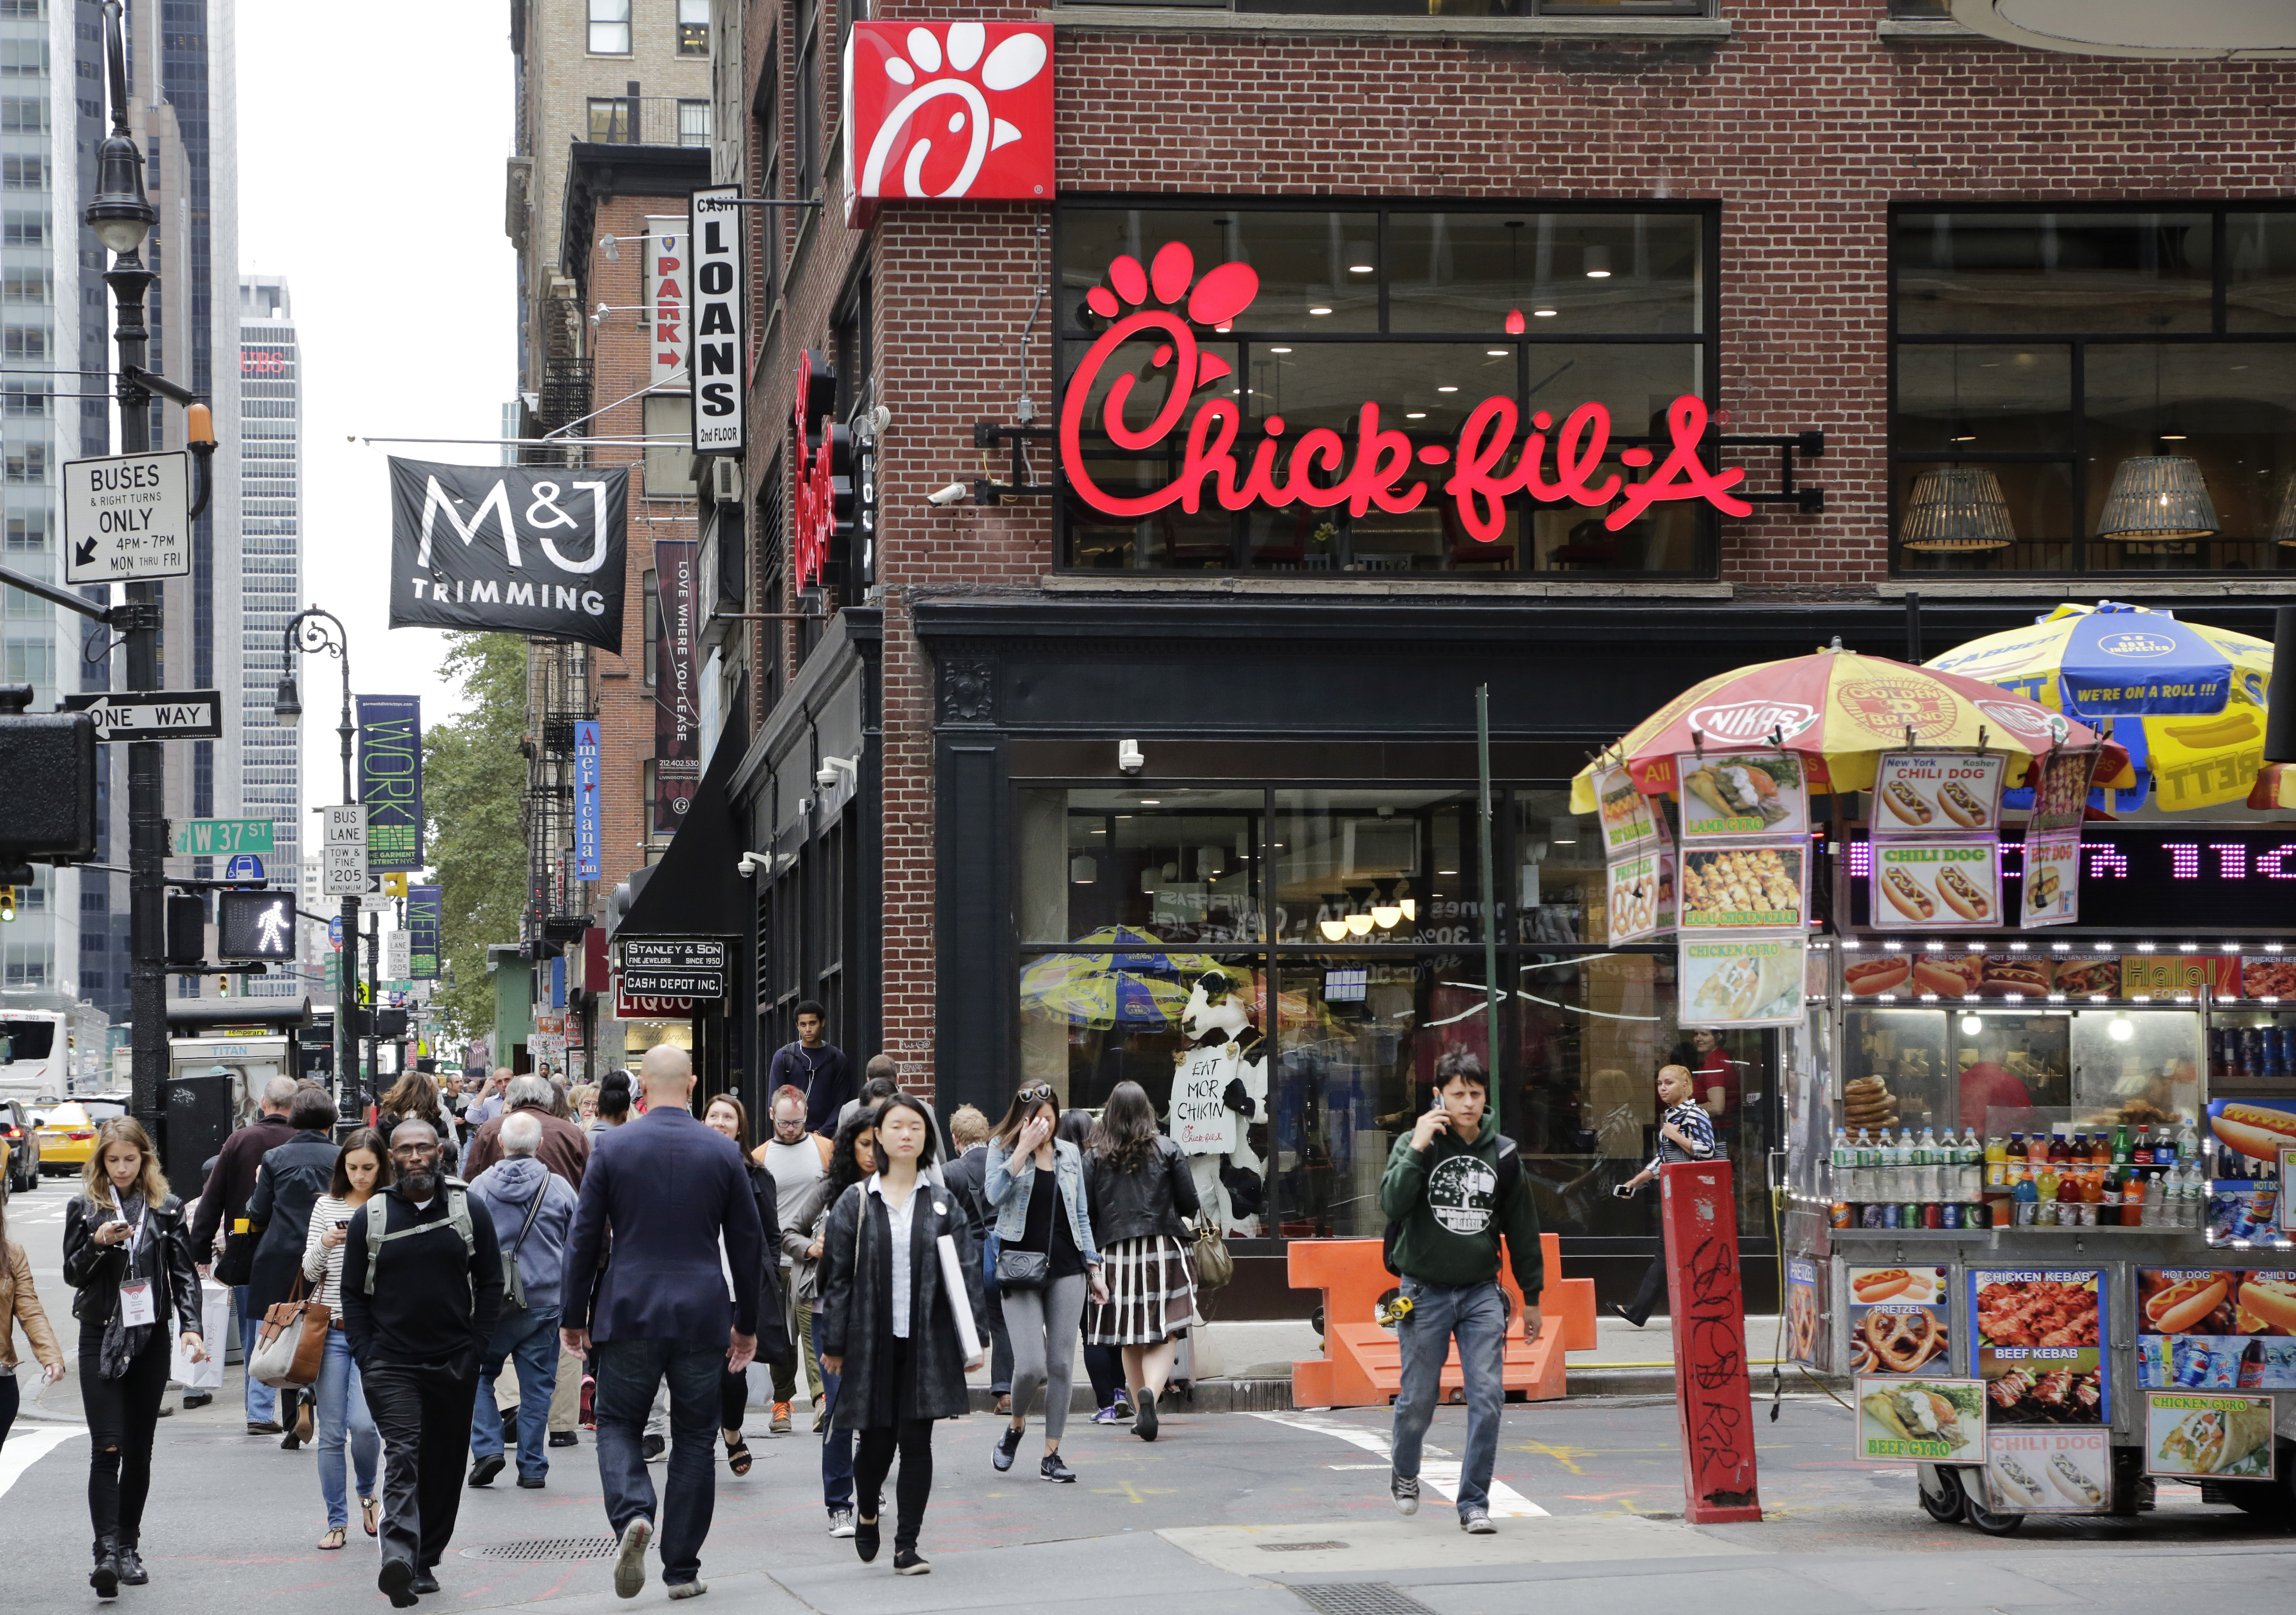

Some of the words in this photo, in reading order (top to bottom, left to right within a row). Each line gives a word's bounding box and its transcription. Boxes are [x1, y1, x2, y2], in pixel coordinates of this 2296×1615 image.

[656, 257, 682, 343] PARK
[699, 221, 735, 416] LOANS
[240, 351, 284, 372] UBS
[1060, 242, 1753, 541] Chick-fil-A
[700, 430, 712, 442] 2nd
[714, 427, 737, 441] FLOOR
[91, 464, 159, 491] BUSES
[91, 498, 97, 506] &
[101, 495, 127, 506] RIGHT
[130, 492, 161, 503] TURNS
[100, 508, 153, 533] ONLY
[417, 475, 607, 574] M&J
[116, 538, 140, 550] 4PM
[151, 535, 174, 548] 7PM
[111, 556, 133, 571] MON
[140, 556, 158, 566] THRU
[164, 552, 180, 566] FRI
[679, 562, 688, 597] LOVE
[412, 578, 604, 615] TRIMMING
[677, 607, 688, 655] WHERE
[1933, 633, 2064, 670] SABRETT
[677, 662, 687, 690] YOU
[1834, 677, 1920, 686] MANUFACTURED
[1849, 687, 1939, 699] GOLDEN
[2077, 688, 2121, 702] WE'RE
[2125, 688, 2144, 700] ON
[2148, 686, 2158, 698] A
[2162, 685, 2197, 698] ROLL
[91, 708, 133, 727] ONE
[155, 707, 200, 725] WAY
[677, 697, 687, 741] LEASE
[1707, 706, 1799, 736] NIKAS
[1871, 712, 1944, 725] BRAND
[1854, 722, 1900, 745] Brooklyn
[364, 718, 415, 820] WORK
[1887, 758, 1909, 767] New
[1914, 758, 1936, 767] York
[1963, 758, 1996, 768] Kosher
[1644, 764, 1671, 783] All
[1897, 768, 1942, 778] CHILI
[1949, 768, 1985, 778] DOG
[578, 727, 597, 857] Americana
[334, 812, 356, 823] BUS
[1688, 818, 1724, 833] LAMB
[1727, 816, 1764, 832] GYRO
[194, 825, 212, 851] W
[219, 823, 243, 850] 37
[249, 823, 267, 837] ST
[331, 828, 360, 840] LANE
[330, 849, 350, 857] TOW
[1885, 849, 1940, 862] CHILI
[1943, 848, 1986, 861] DOG
[2031, 845, 2051, 864] HOT
[2055, 844, 2073, 861] DOG
[335, 858, 355, 866] FINE
[578, 860, 597, 875] Inn
[330, 870, 361, 882] $205
[1686, 912, 1719, 926] HALAL
[1720, 911, 1762, 925] CHICKEN
[1764, 910, 1797, 924] KEBAB
[1688, 944, 1743, 957] CHICKEN
[1746, 943, 1780, 956] GYRO
[2127, 959, 2217, 987] Halal
[628, 978, 656, 988] CASH
[660, 978, 695, 990] DEPOT
[698, 980, 718, 990] INC.
[2154, 989, 2191, 999] FOOD
[212, 1046, 247, 1056] TITAN
[1192, 1059, 1222, 1076] EAT
[1187, 1079, 1219, 1100] MOR
[1178, 1101, 1225, 1122] CHIKIN
[1182, 1125, 1223, 1143] Chick-fil-A
[2253, 1182, 2267, 1190] HOT
[1791, 1261, 1815, 1283] PRETZEL
[1984, 1272, 2042, 1282] CHICKEN
[2045, 1272, 2090, 1282] KEBAB
[2162, 1270, 2183, 1279] HOT
[2187, 1270, 2211, 1279] DOG
[2258, 1271, 2285, 1280] CHILI
[1875, 1305, 1923, 1314] PRETZEL
[1995, 1349, 2029, 1359] BEEF
[2033, 1349, 2078, 1359] KEBAB
[2152, 1396, 2209, 1410] CHICKEN
[2212, 1398, 2247, 1412] GYRO
[1867, 1438, 1905, 1455] BEEF
[1907, 1440, 1951, 1458] GYRO
[1990, 1436, 2052, 1451] CHILI
[2055, 1436, 2102, 1451] DOG
